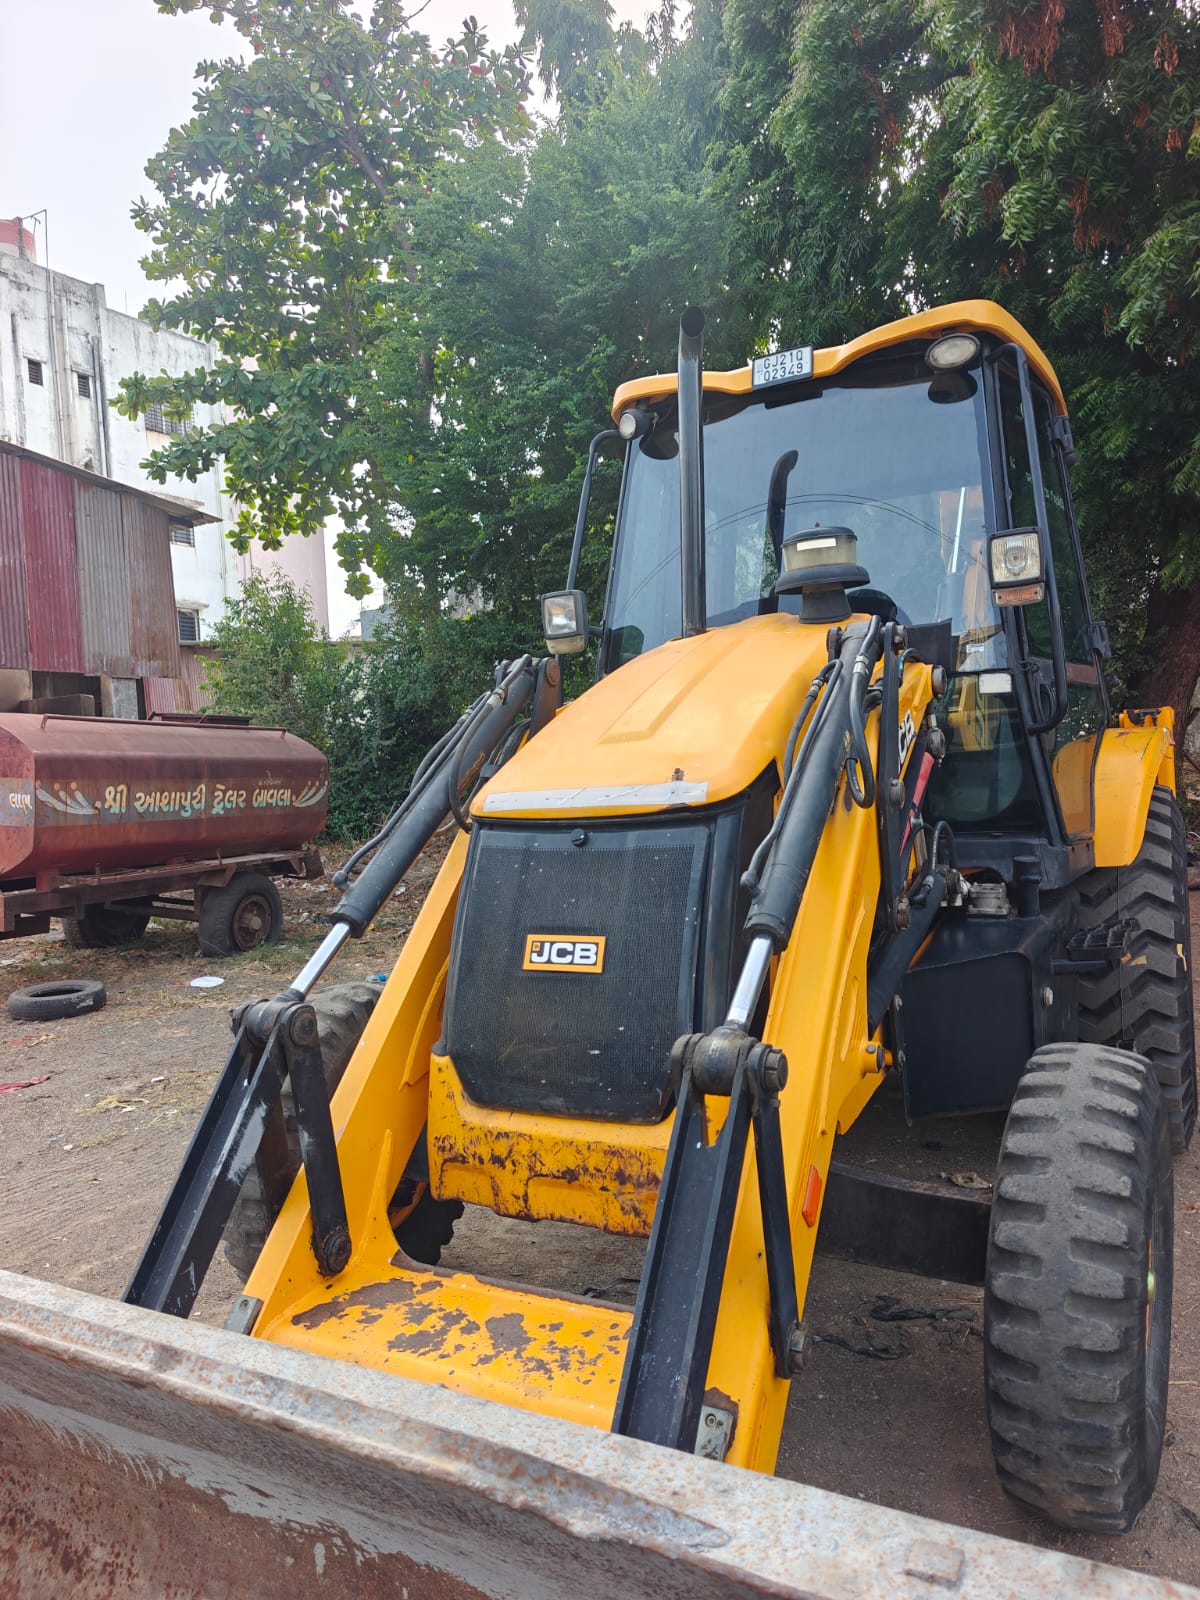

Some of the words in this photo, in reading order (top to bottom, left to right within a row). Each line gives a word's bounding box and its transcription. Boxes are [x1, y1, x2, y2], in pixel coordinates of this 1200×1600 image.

[104, 784, 127, 814] શ્રી
[134, 784, 206, 817] આશાપુરી
[531, 942, 597, 964] JCB
